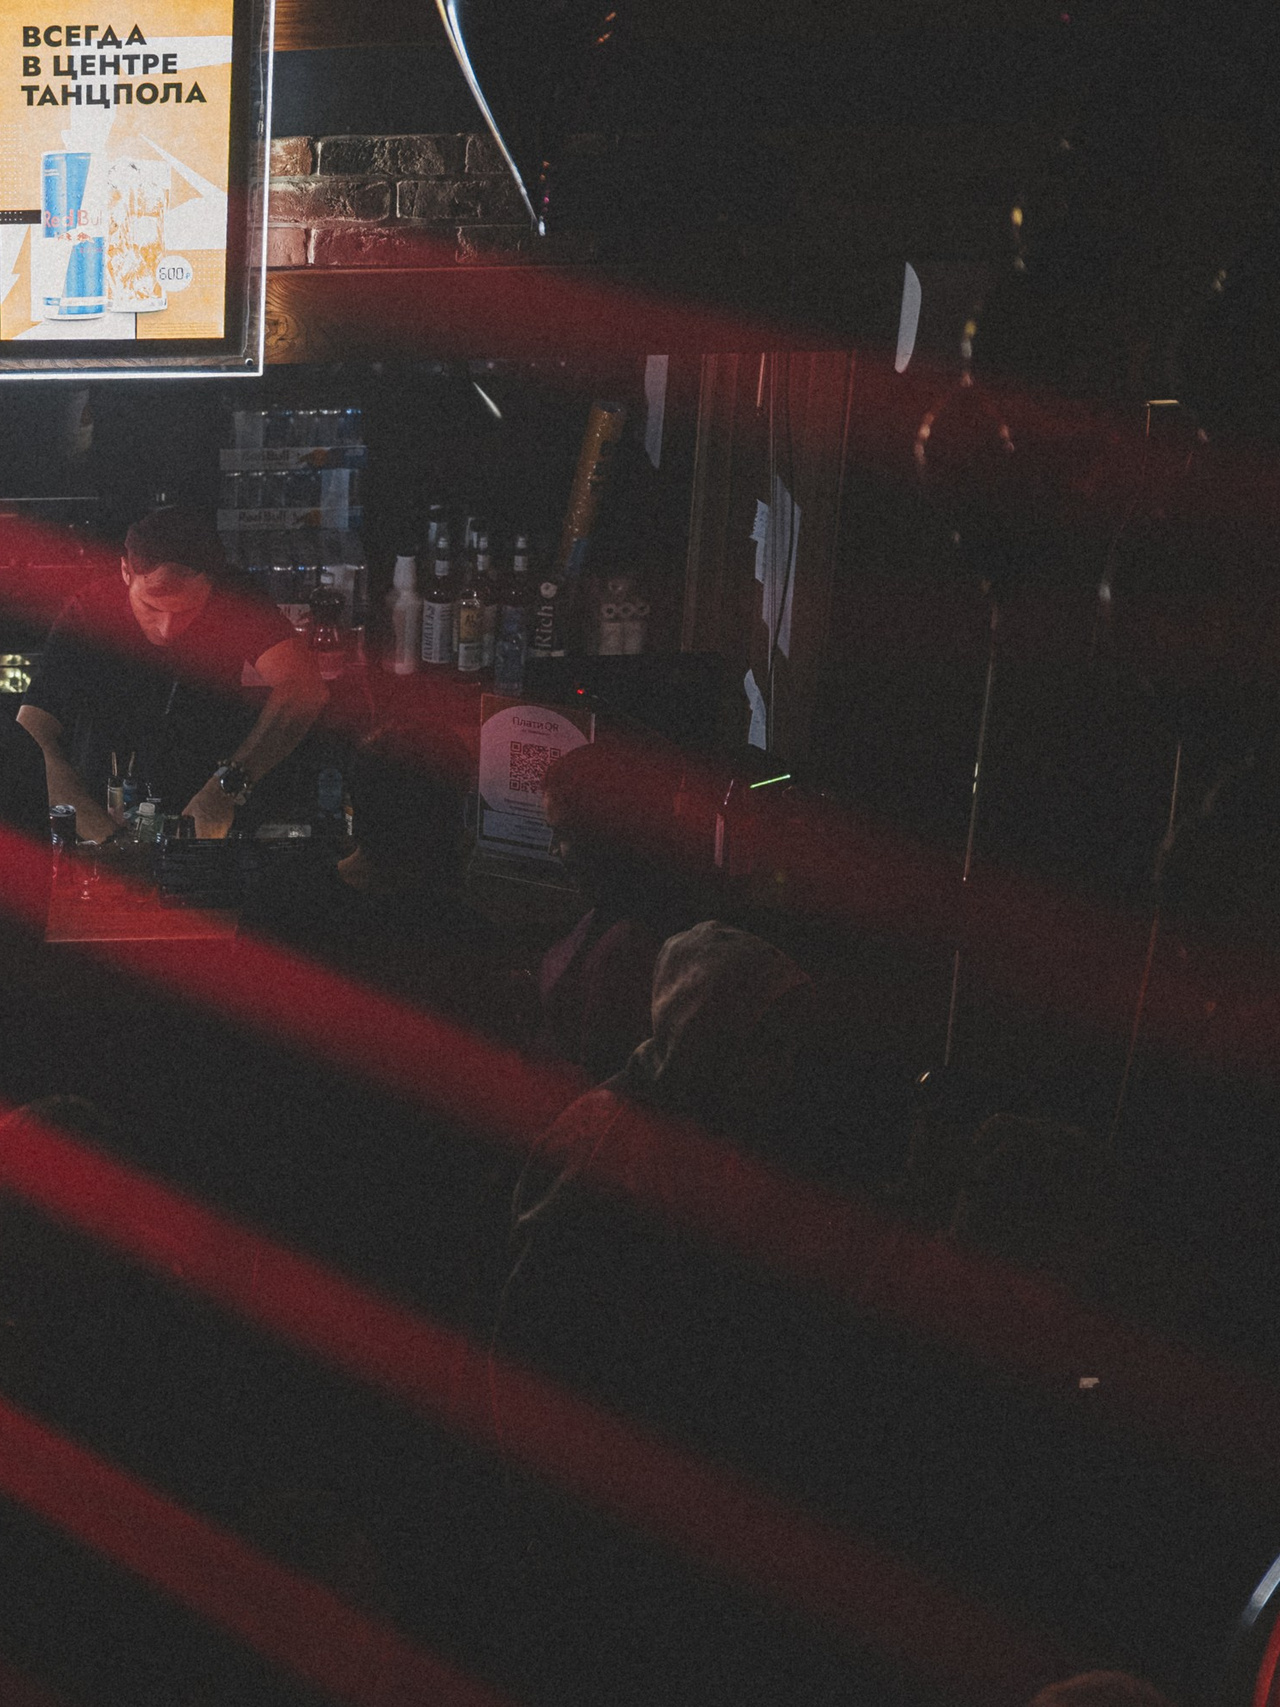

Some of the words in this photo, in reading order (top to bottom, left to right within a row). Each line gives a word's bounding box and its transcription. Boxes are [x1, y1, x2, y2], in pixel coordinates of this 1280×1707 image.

[22, 23, 147, 50] ВСЕГДА
[22, 56, 41, 77] В
[53, 53, 177, 80] ЦЕНТРЕ
[21, 81, 207, 109] ТАНЦПОЛА
[43, 209, 74, 228] Red
[77, 209, 104, 227] Bul
[534, 604, 554, 649] Rich
[512, 716, 544, 730] Плати
[545, 721, 559, 733] QR
